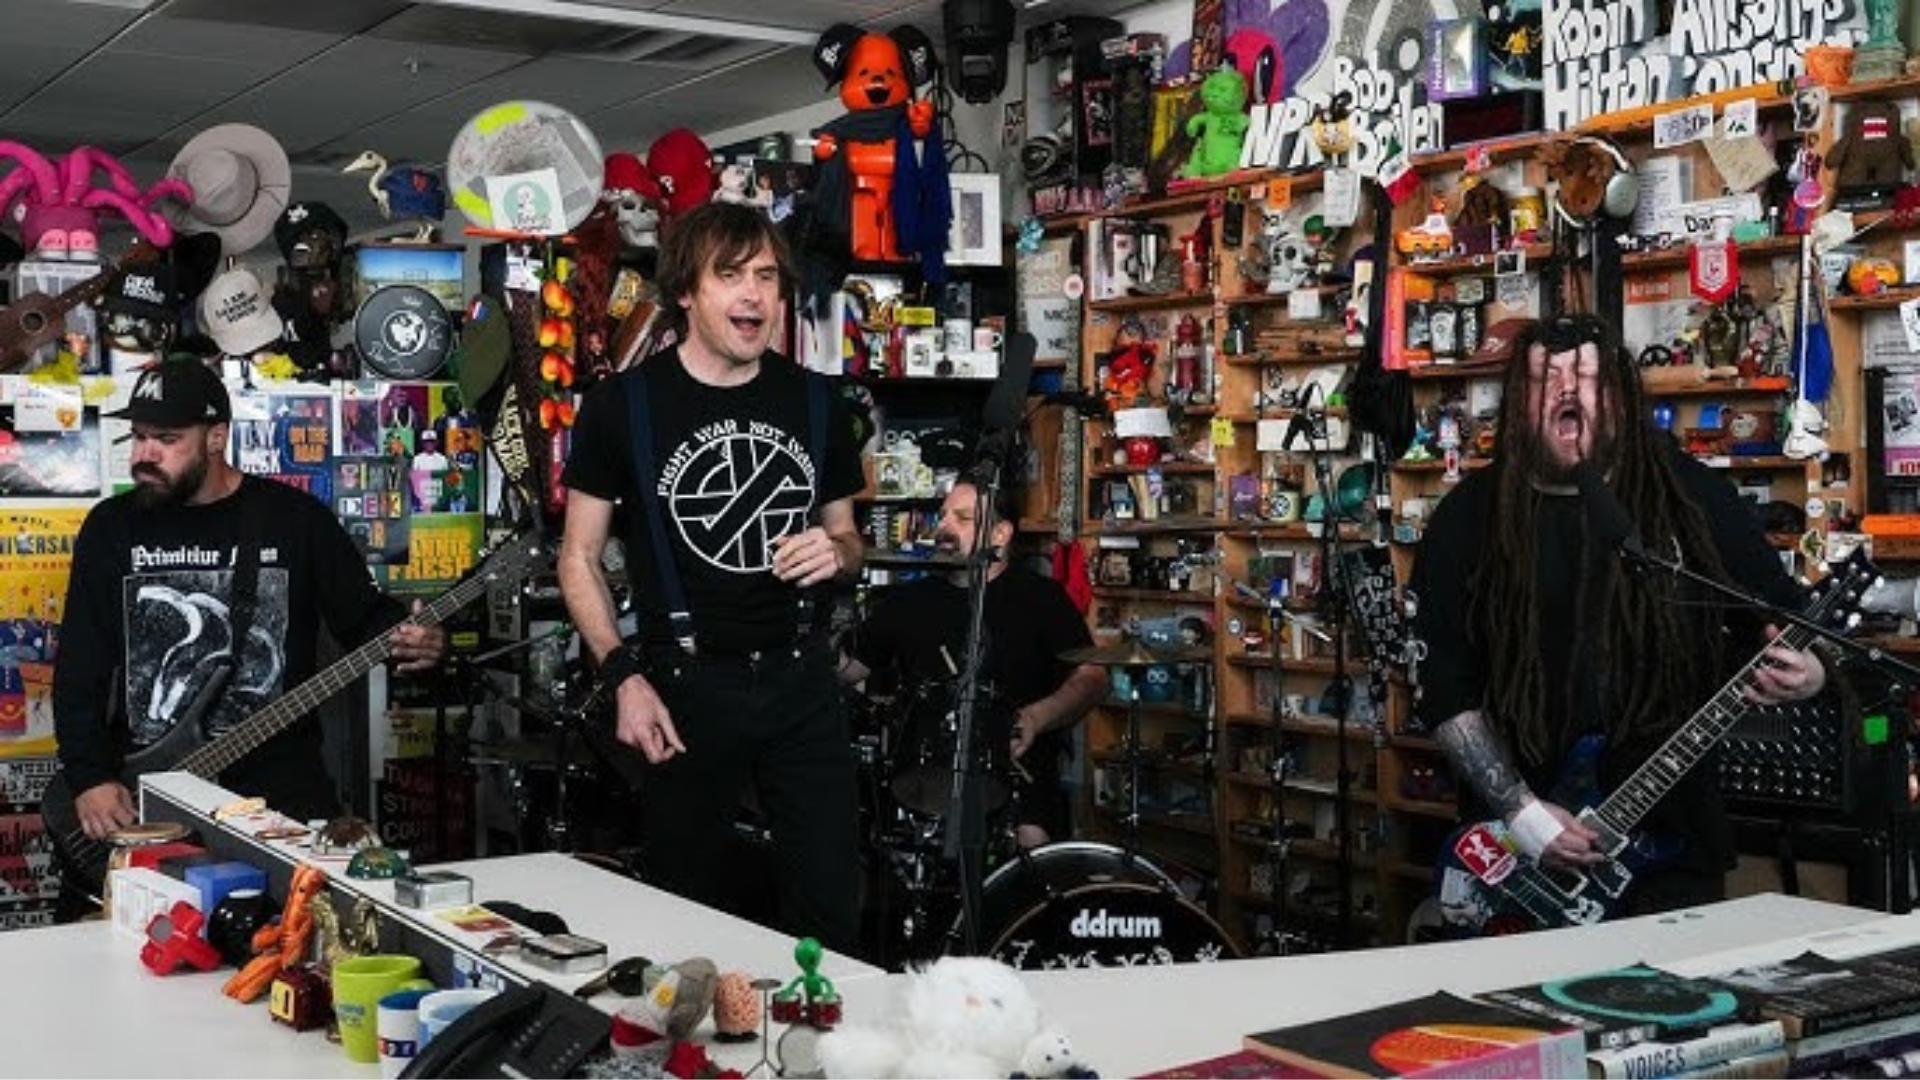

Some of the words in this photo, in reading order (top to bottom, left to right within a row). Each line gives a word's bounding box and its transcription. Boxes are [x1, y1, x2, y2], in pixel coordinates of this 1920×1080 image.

[1542, 0, 1645, 65] Robin
[1543, 48, 1670, 131] Hilton
[694, 418, 738, 442] WAR
[749, 419, 786, 440] NOT
[1070, 908, 1162, 938] ddrum
[1623, 1044, 1686, 1079] VOICES
